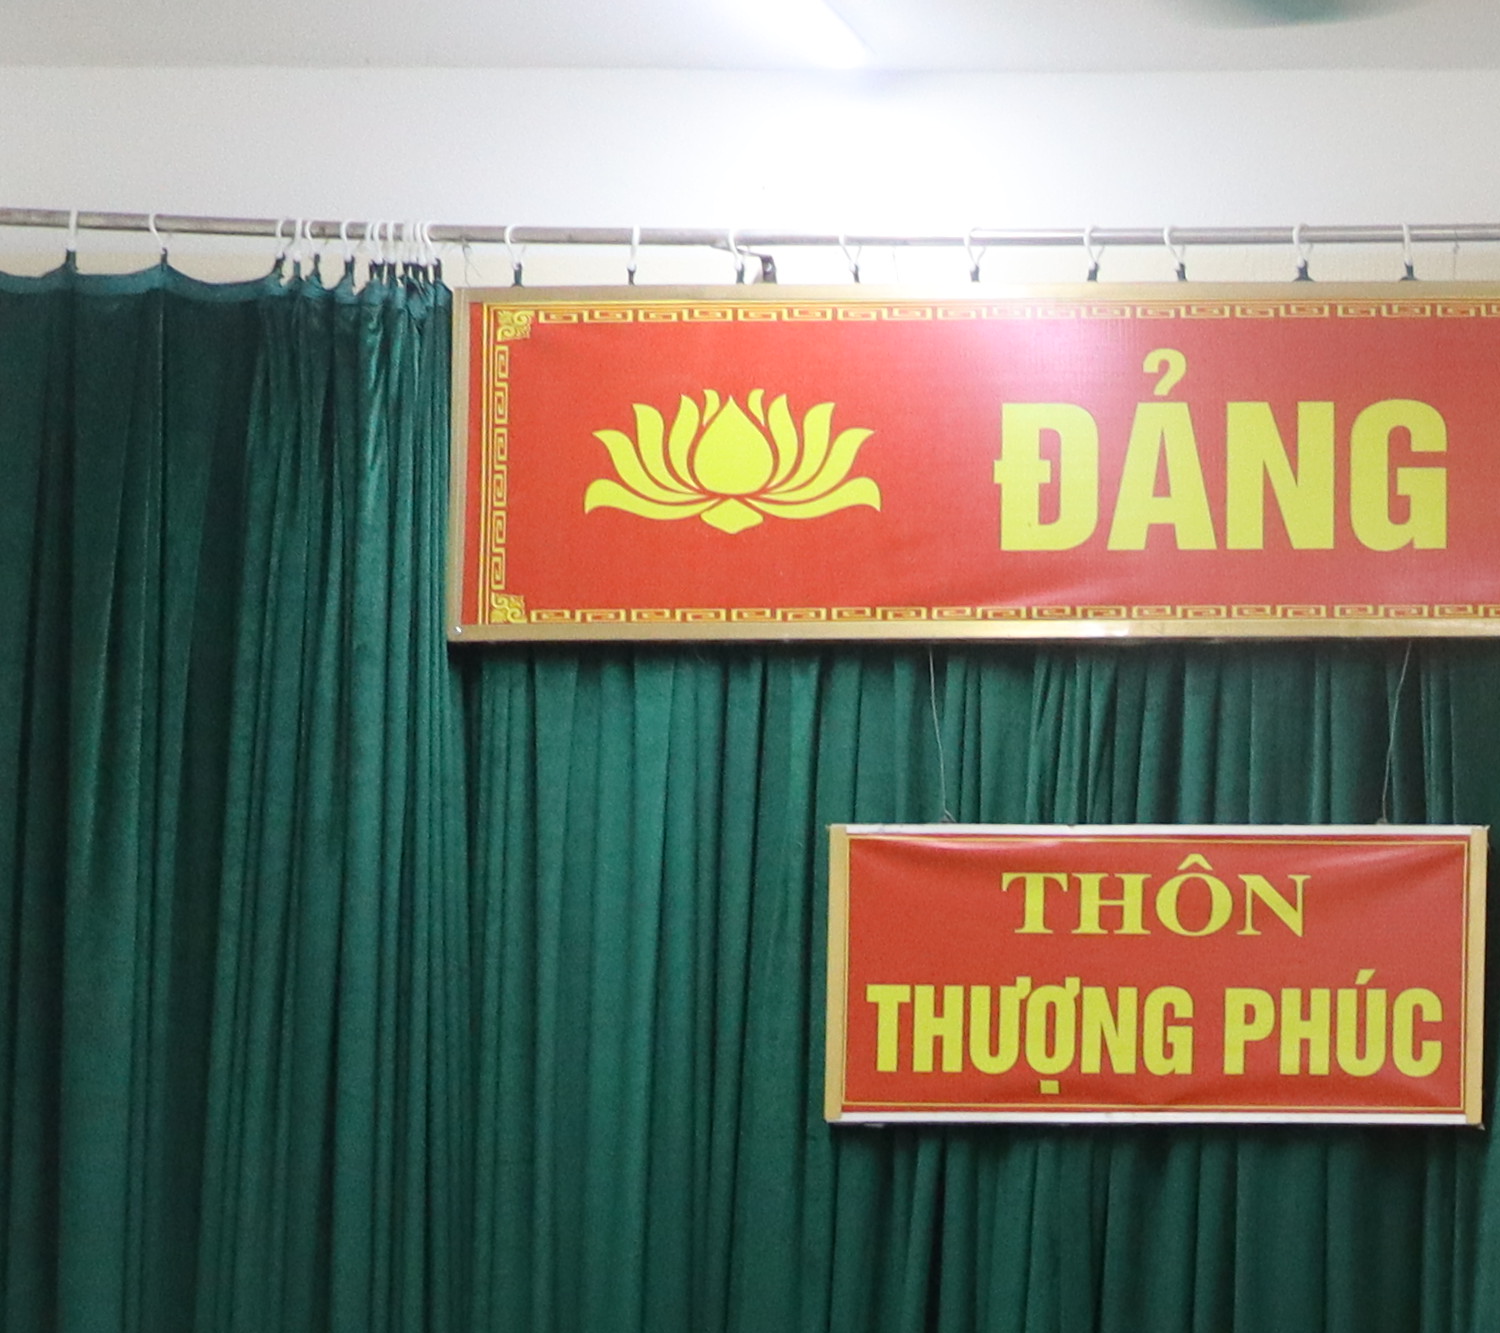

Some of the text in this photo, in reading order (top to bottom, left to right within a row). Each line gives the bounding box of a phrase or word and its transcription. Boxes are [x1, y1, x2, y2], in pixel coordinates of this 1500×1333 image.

[992, 348, 1448, 552] ĐẢNG
[1001, 852, 1311, 938] THÔN
[866, 968, 1443, 1096] THƯỢNG PHÚC
